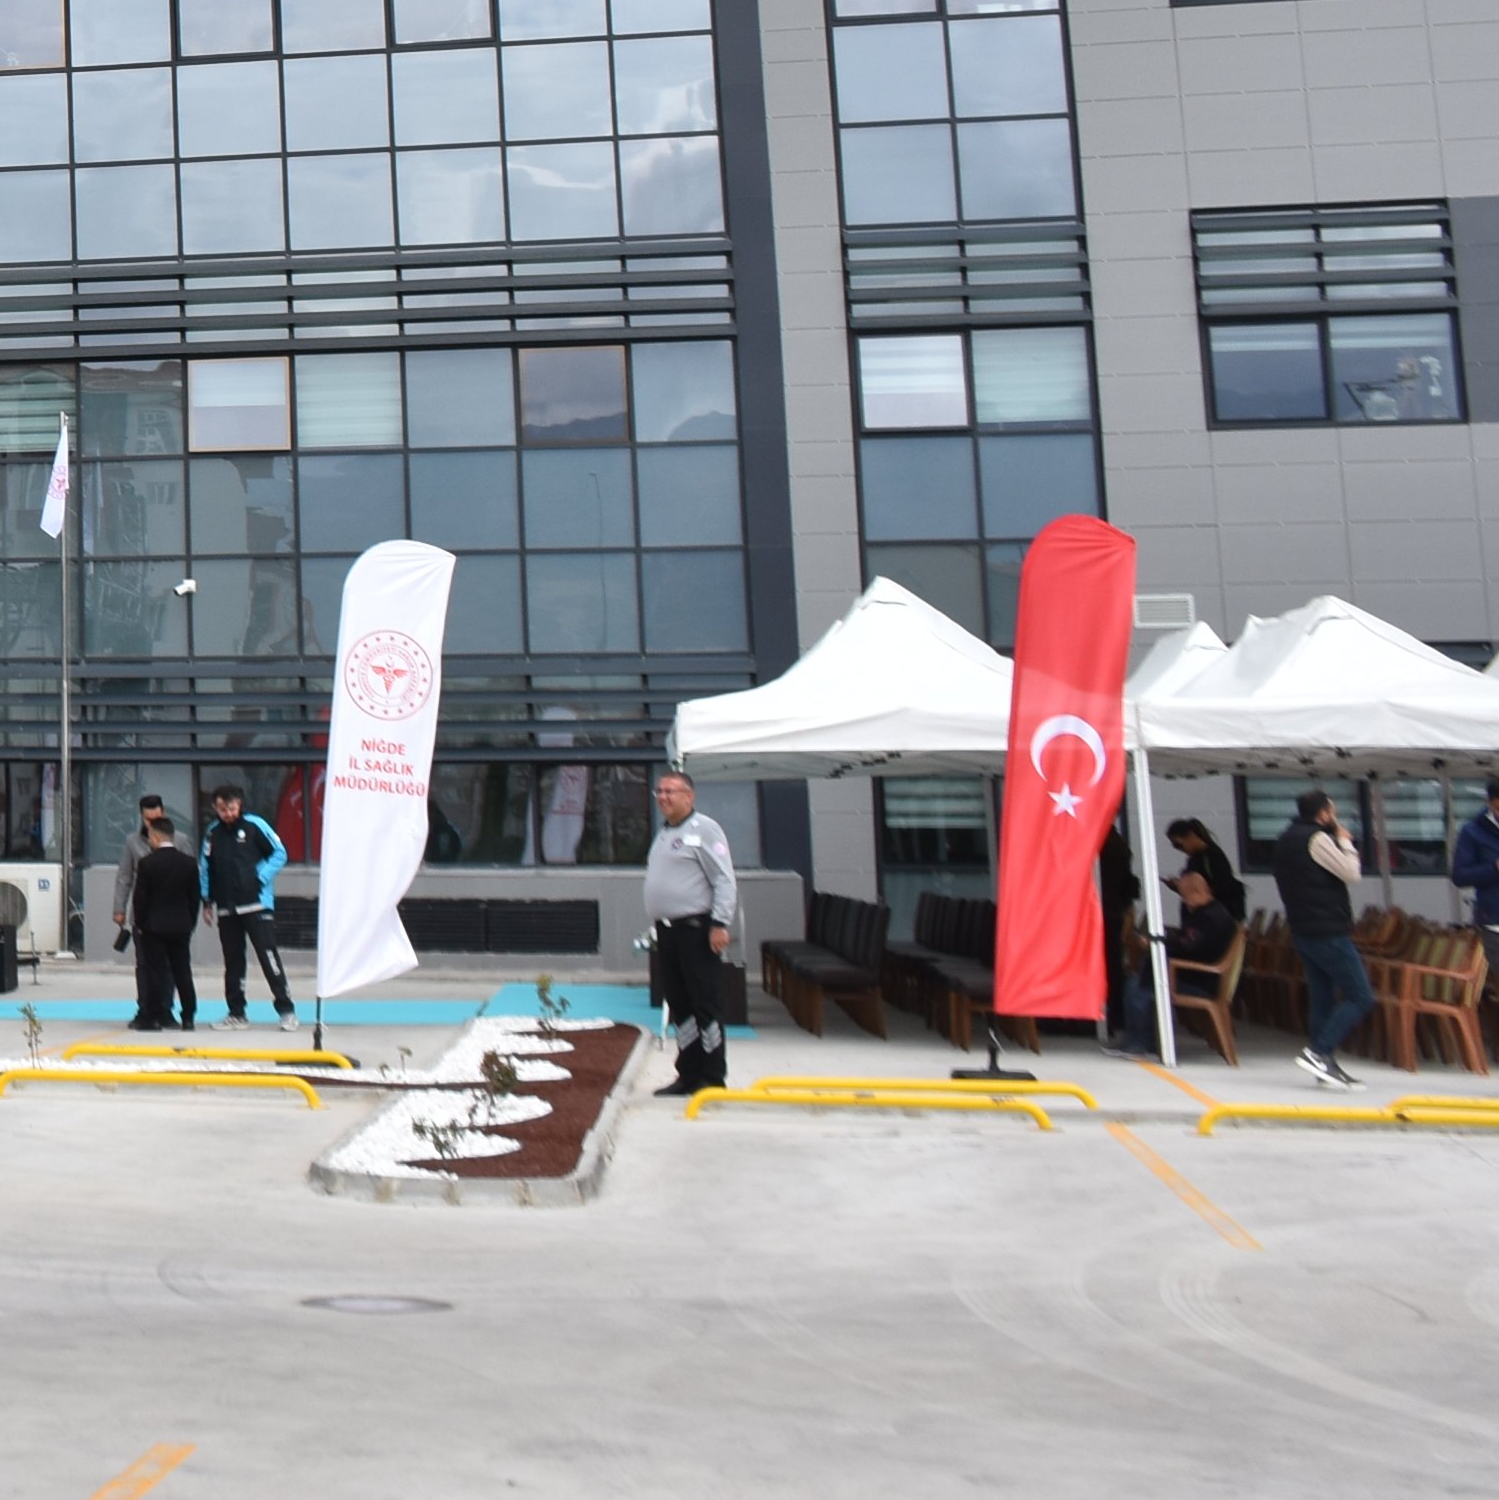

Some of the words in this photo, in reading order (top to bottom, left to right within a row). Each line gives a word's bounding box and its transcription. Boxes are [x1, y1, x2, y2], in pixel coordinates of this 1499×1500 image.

[361, 738, 407, 756] NİĞDE
[349, 755, 360, 770] İL
[364, 759, 414, 776] SAĞLIK
[333, 775, 425, 797] MÜDÜRLÜĞÜ
